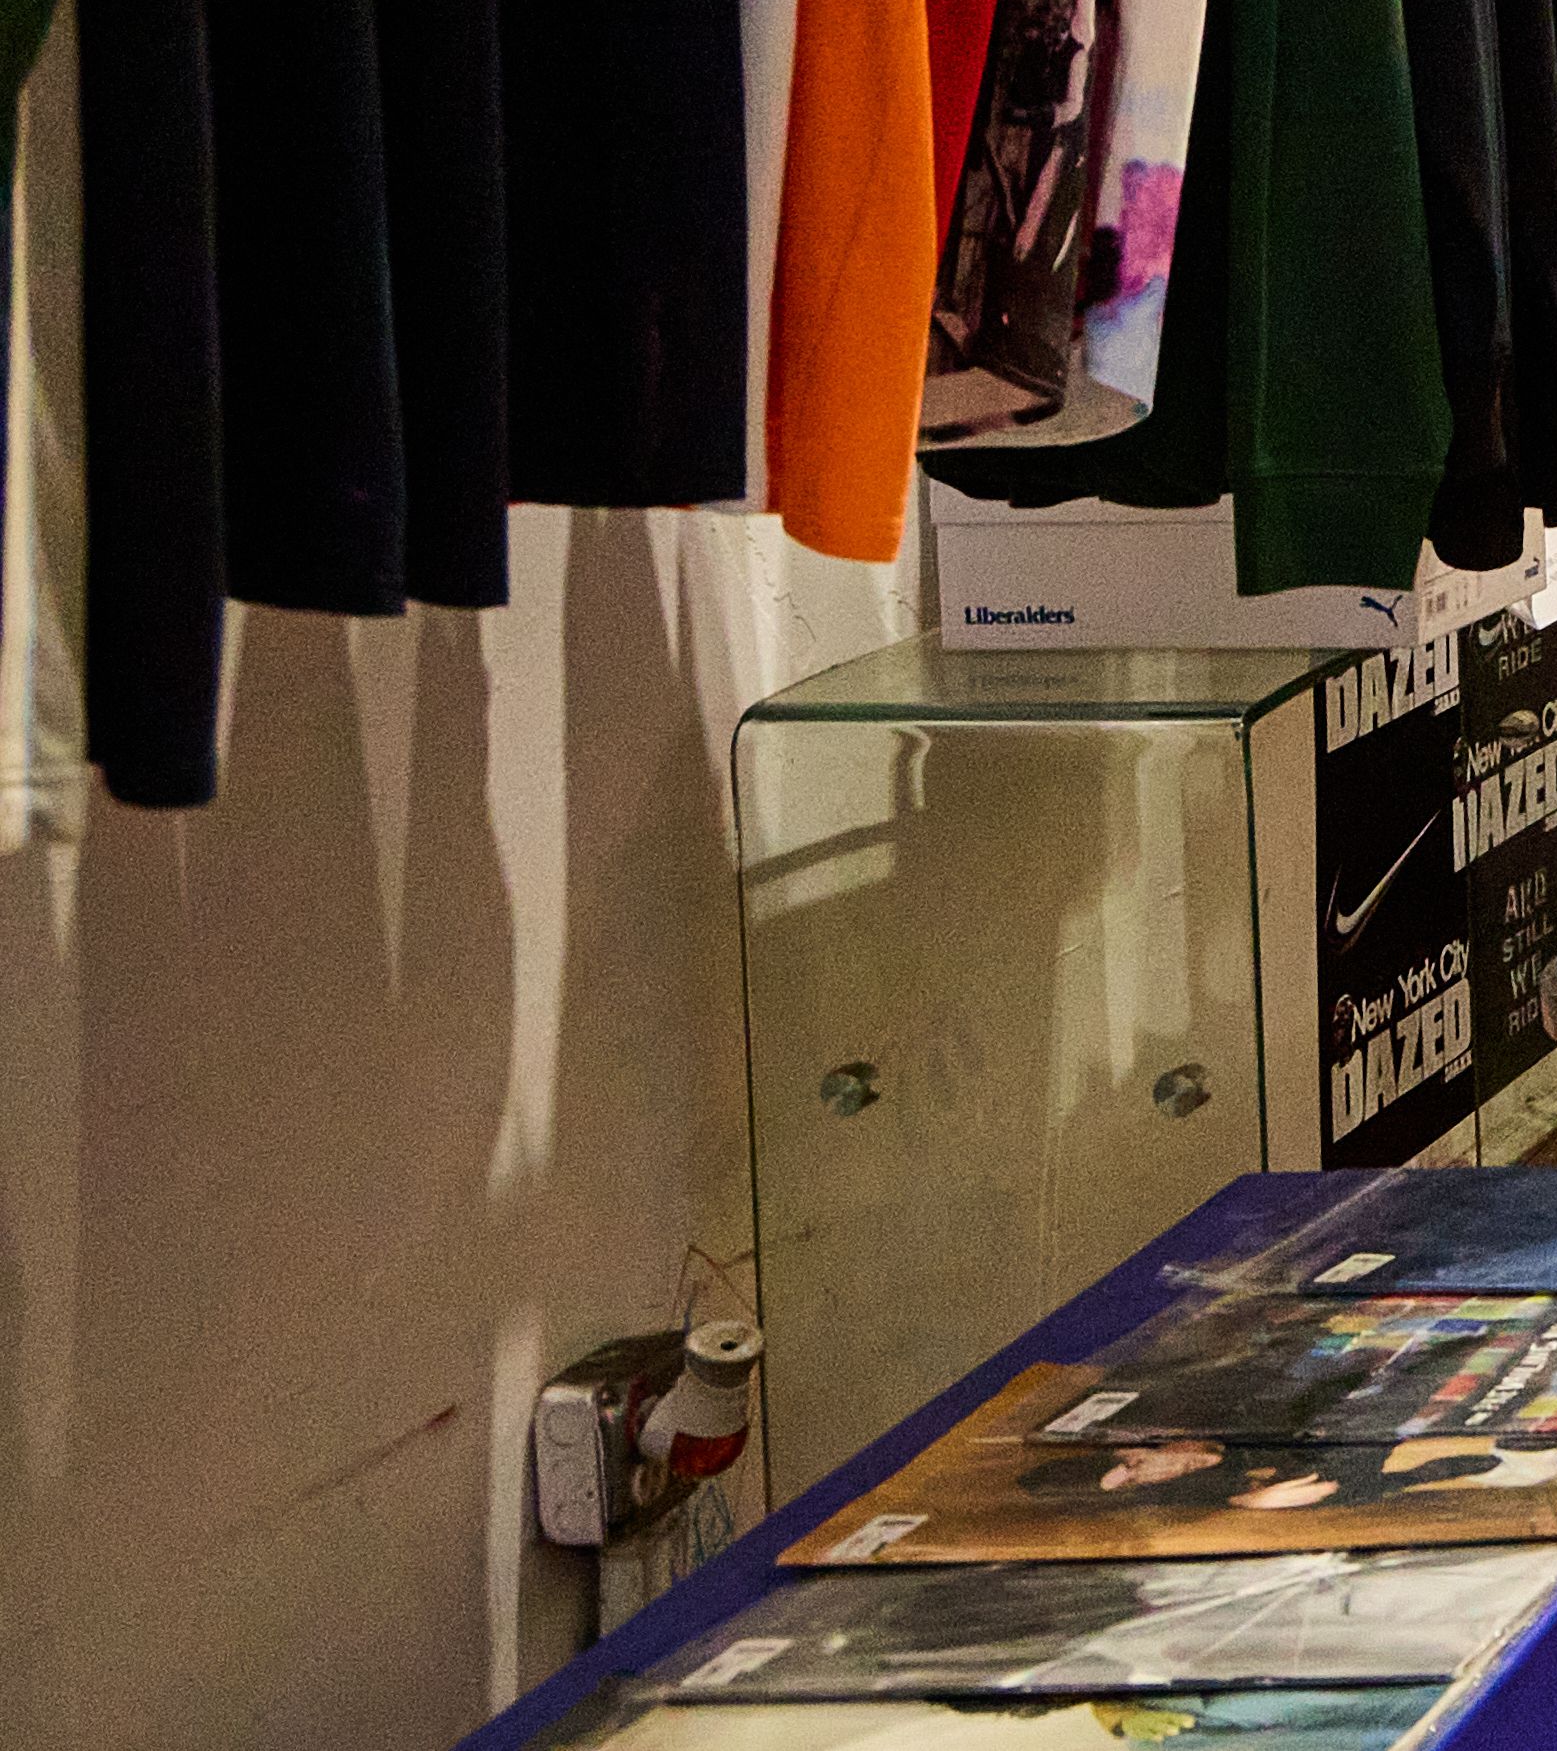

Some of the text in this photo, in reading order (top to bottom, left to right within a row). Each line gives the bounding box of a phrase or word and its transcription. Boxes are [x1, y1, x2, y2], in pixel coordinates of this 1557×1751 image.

[1326, 631, 1460, 753] DAZED
[1502, 914, 1554, 965] STILL
[1509, 954, 1541, 1002] WE
[1350, 938, 1470, 1042] New York City
[1507, 992, 1541, 1037] RID
[1330, 978, 1472, 1144] DAZED
